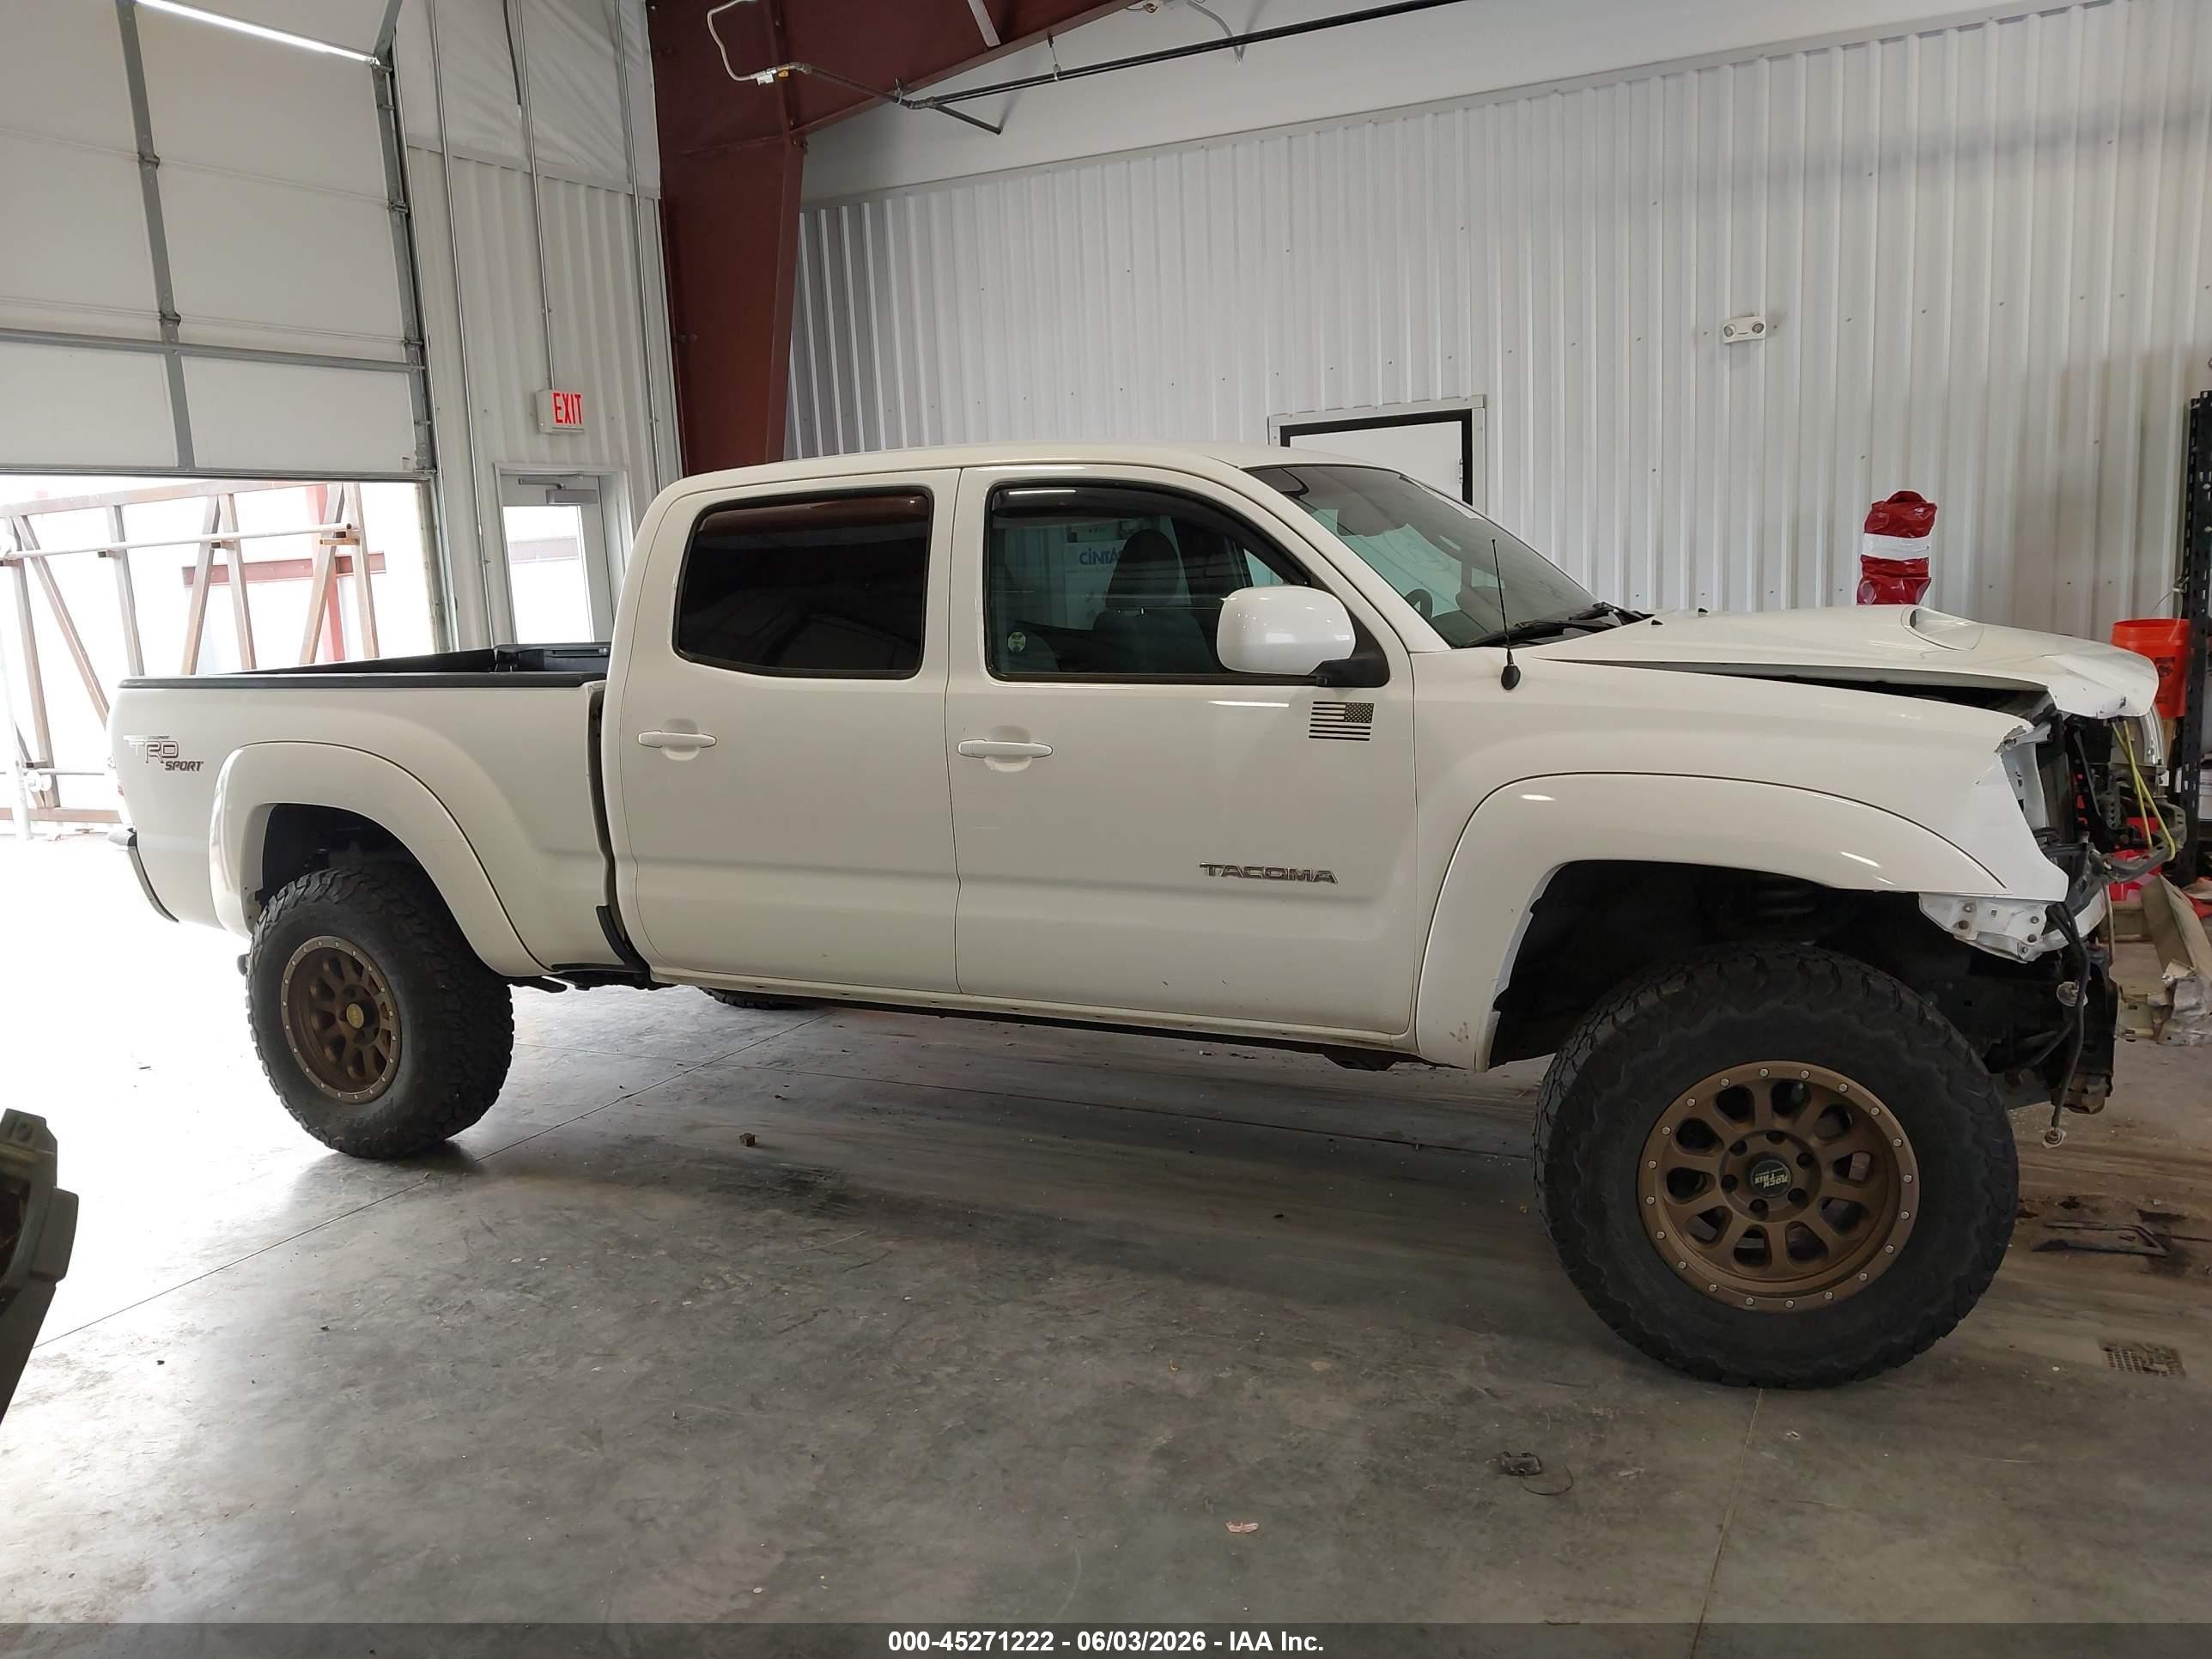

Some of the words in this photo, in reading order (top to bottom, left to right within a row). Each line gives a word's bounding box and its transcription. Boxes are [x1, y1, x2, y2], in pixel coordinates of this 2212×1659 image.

[553, 392, 582, 425] EXIT
[1079, 548, 1121, 565] CINTA
[129, 741, 179, 763] TRD
[164, 761, 204, 772] SPORT
[1200, 862, 1338, 884] TACOMA
[1763, 1174, 1788, 1188] ROCK
